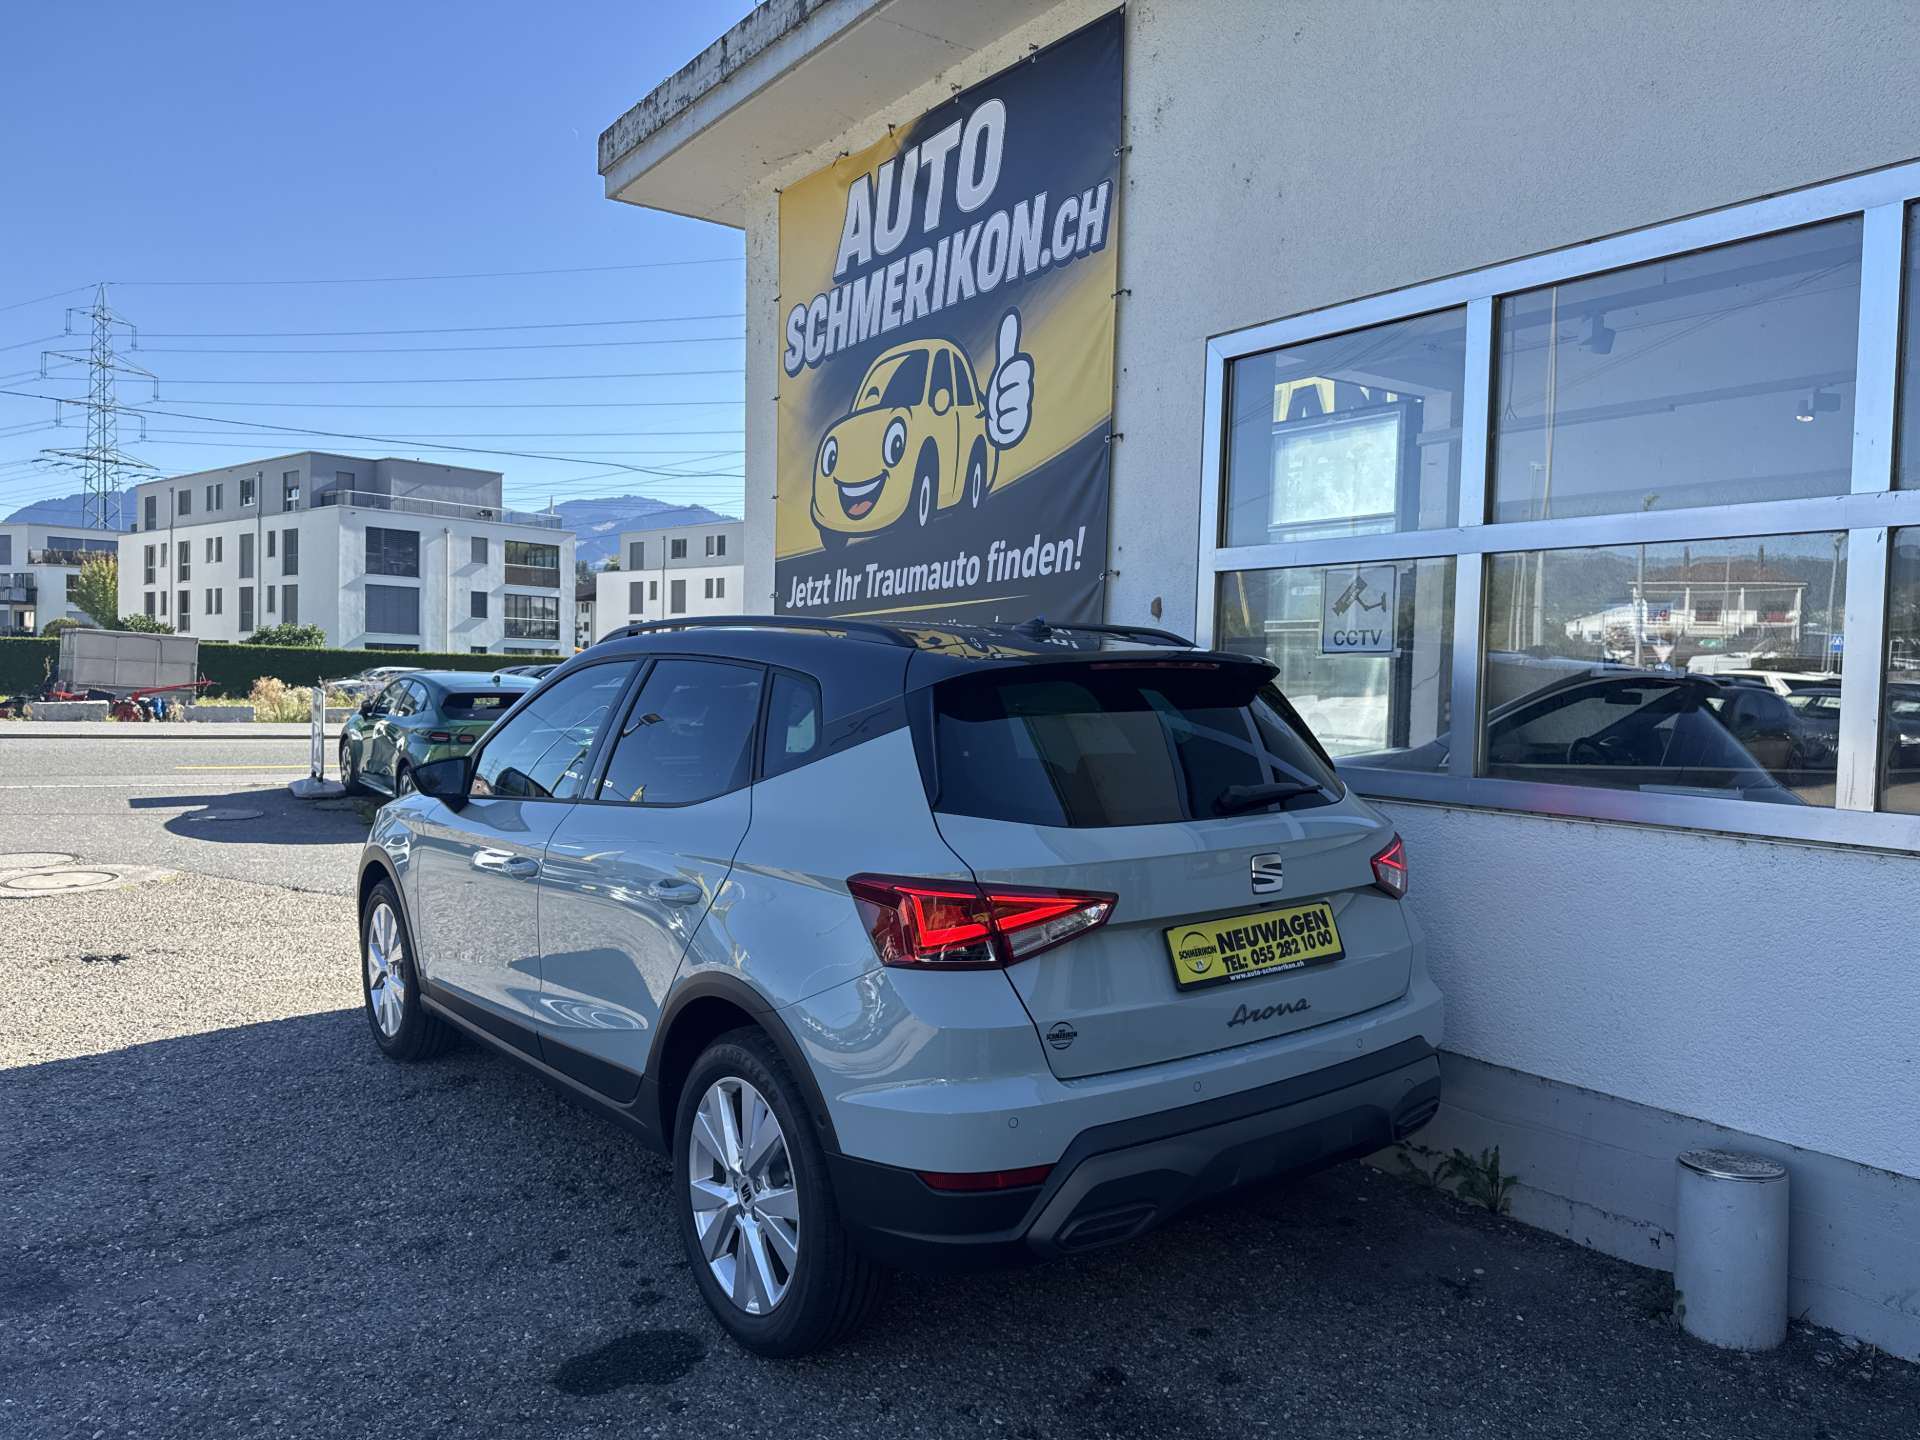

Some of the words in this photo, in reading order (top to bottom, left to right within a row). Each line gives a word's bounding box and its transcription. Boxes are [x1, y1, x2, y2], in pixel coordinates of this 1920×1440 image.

[833, 98, 1006, 278] AUTO
[785, 181, 1110, 373] SCHMERIKON.CH
[786, 576, 831, 608] Jetzt
[834, 567, 861, 602] Ihr
[865, 551, 980, 598] Traumauto
[986, 526, 1086, 583] finden!
[1333, 629, 1383, 647] CCTV
[1216, 909, 1329, 954] NEUWAGEN
[1222, 953, 1248, 973] TEL:
[1251, 944, 1275, 965] 055
[1276, 938, 1301, 958] 282
[1301, 933, 1316, 951] 10
[1316, 929, 1332, 947] 00
[1226, 998, 1311, 1028] Arona
